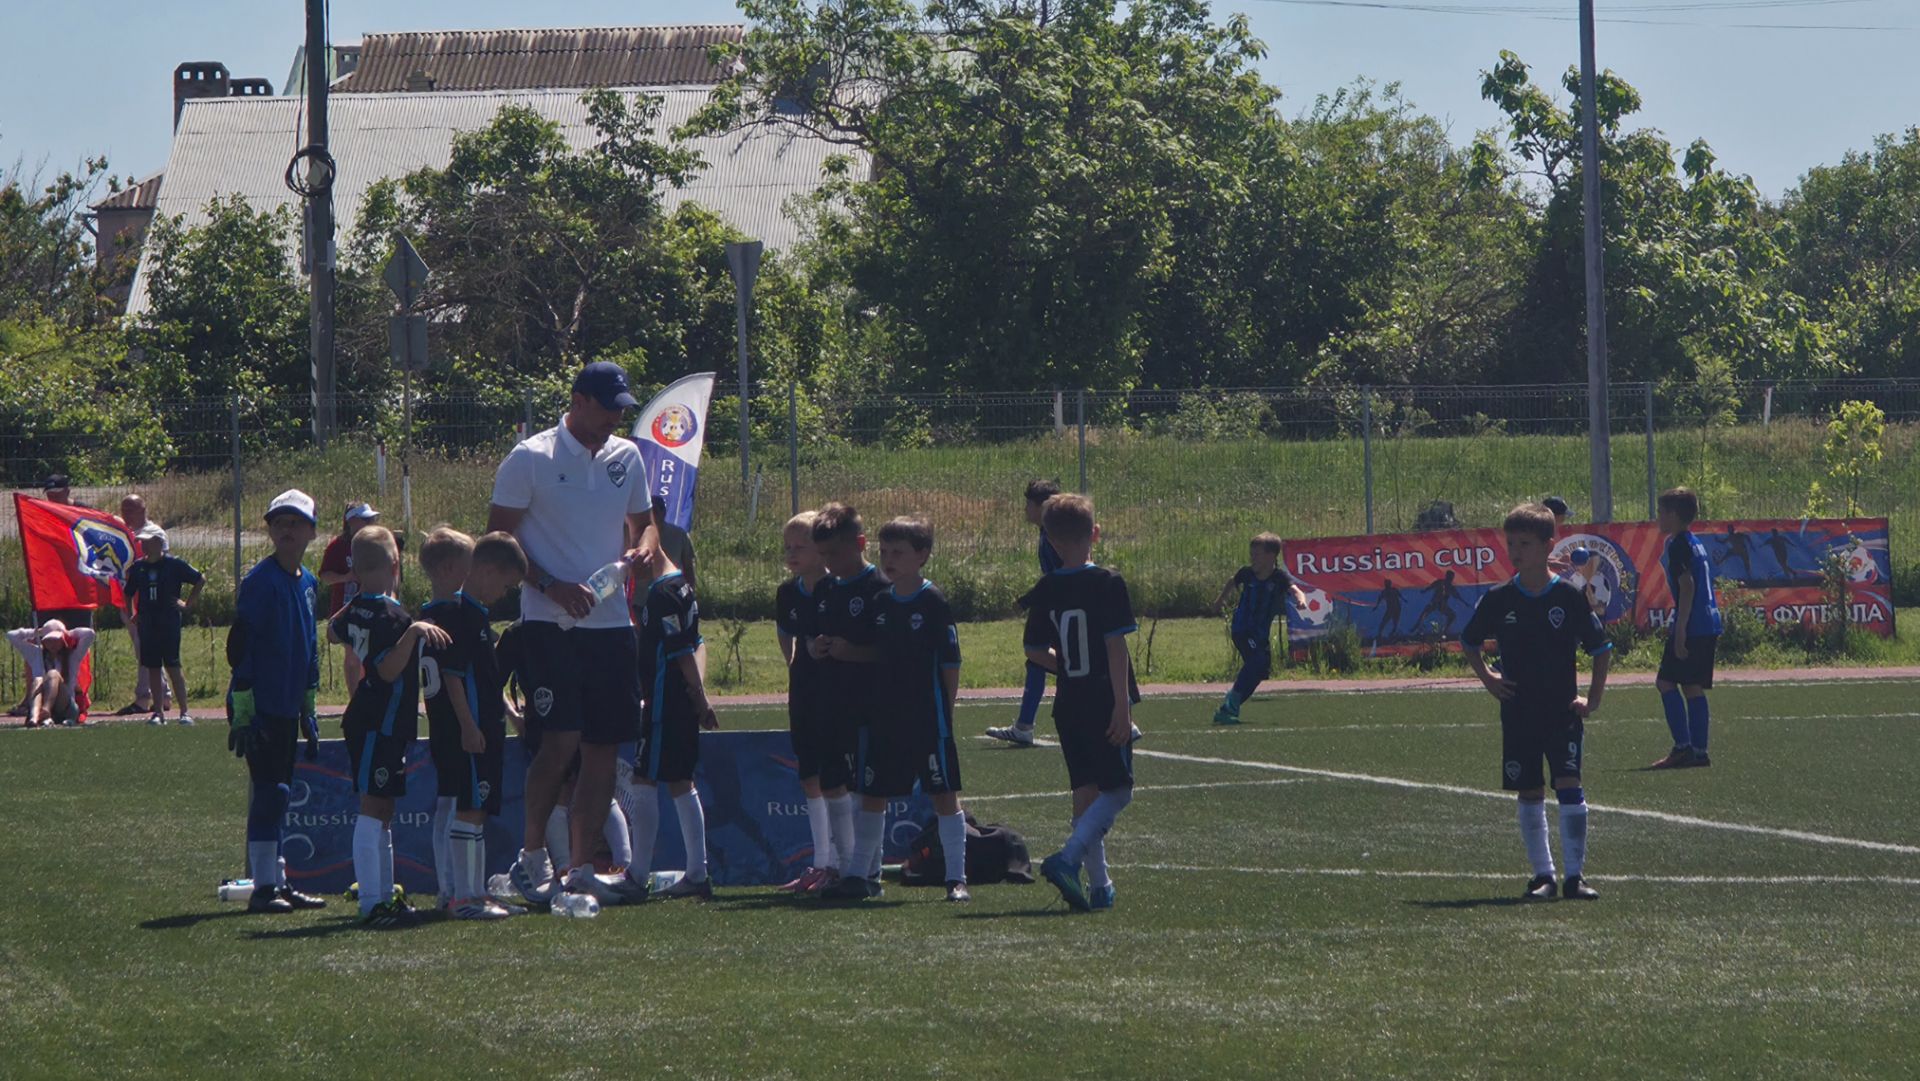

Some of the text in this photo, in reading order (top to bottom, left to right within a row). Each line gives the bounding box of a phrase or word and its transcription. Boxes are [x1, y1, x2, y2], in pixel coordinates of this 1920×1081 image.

[1296, 547, 1495, 574] Russian cup
[1773, 603, 1884, 624] ФУТБЛА
[1567, 742, 1577, 759] 9
